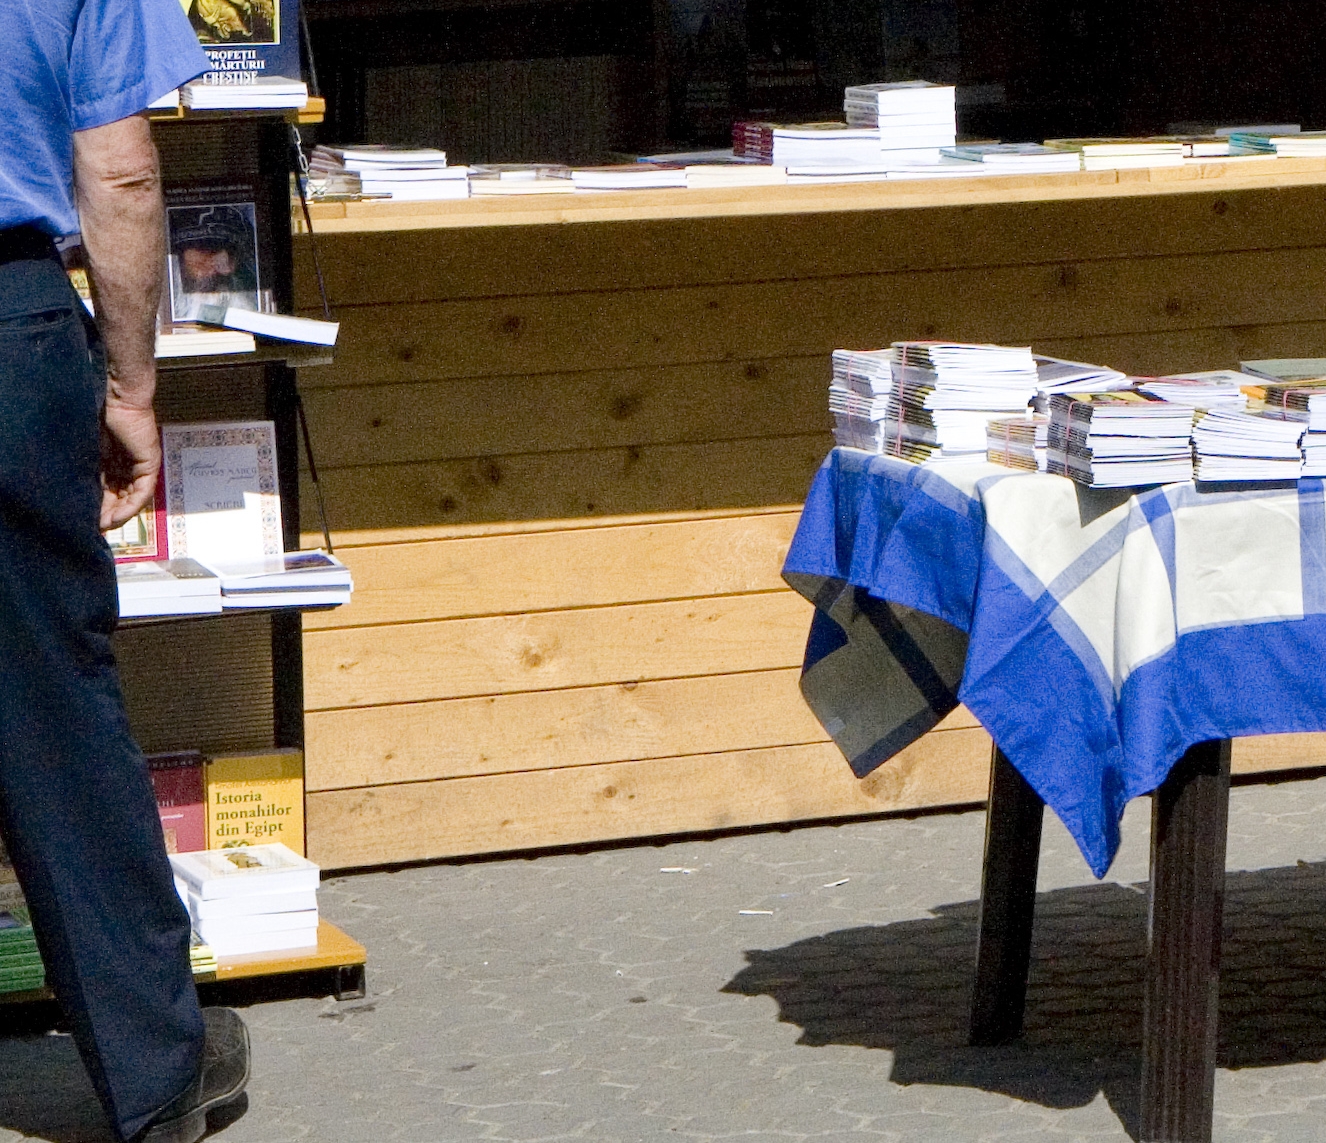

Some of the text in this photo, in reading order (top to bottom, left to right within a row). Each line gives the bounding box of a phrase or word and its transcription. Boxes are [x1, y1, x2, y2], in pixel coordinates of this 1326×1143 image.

[215, 790, 263, 805] Istoria
[216, 803, 292, 820] monahilor
[216, 821, 284, 838] din Egipt
